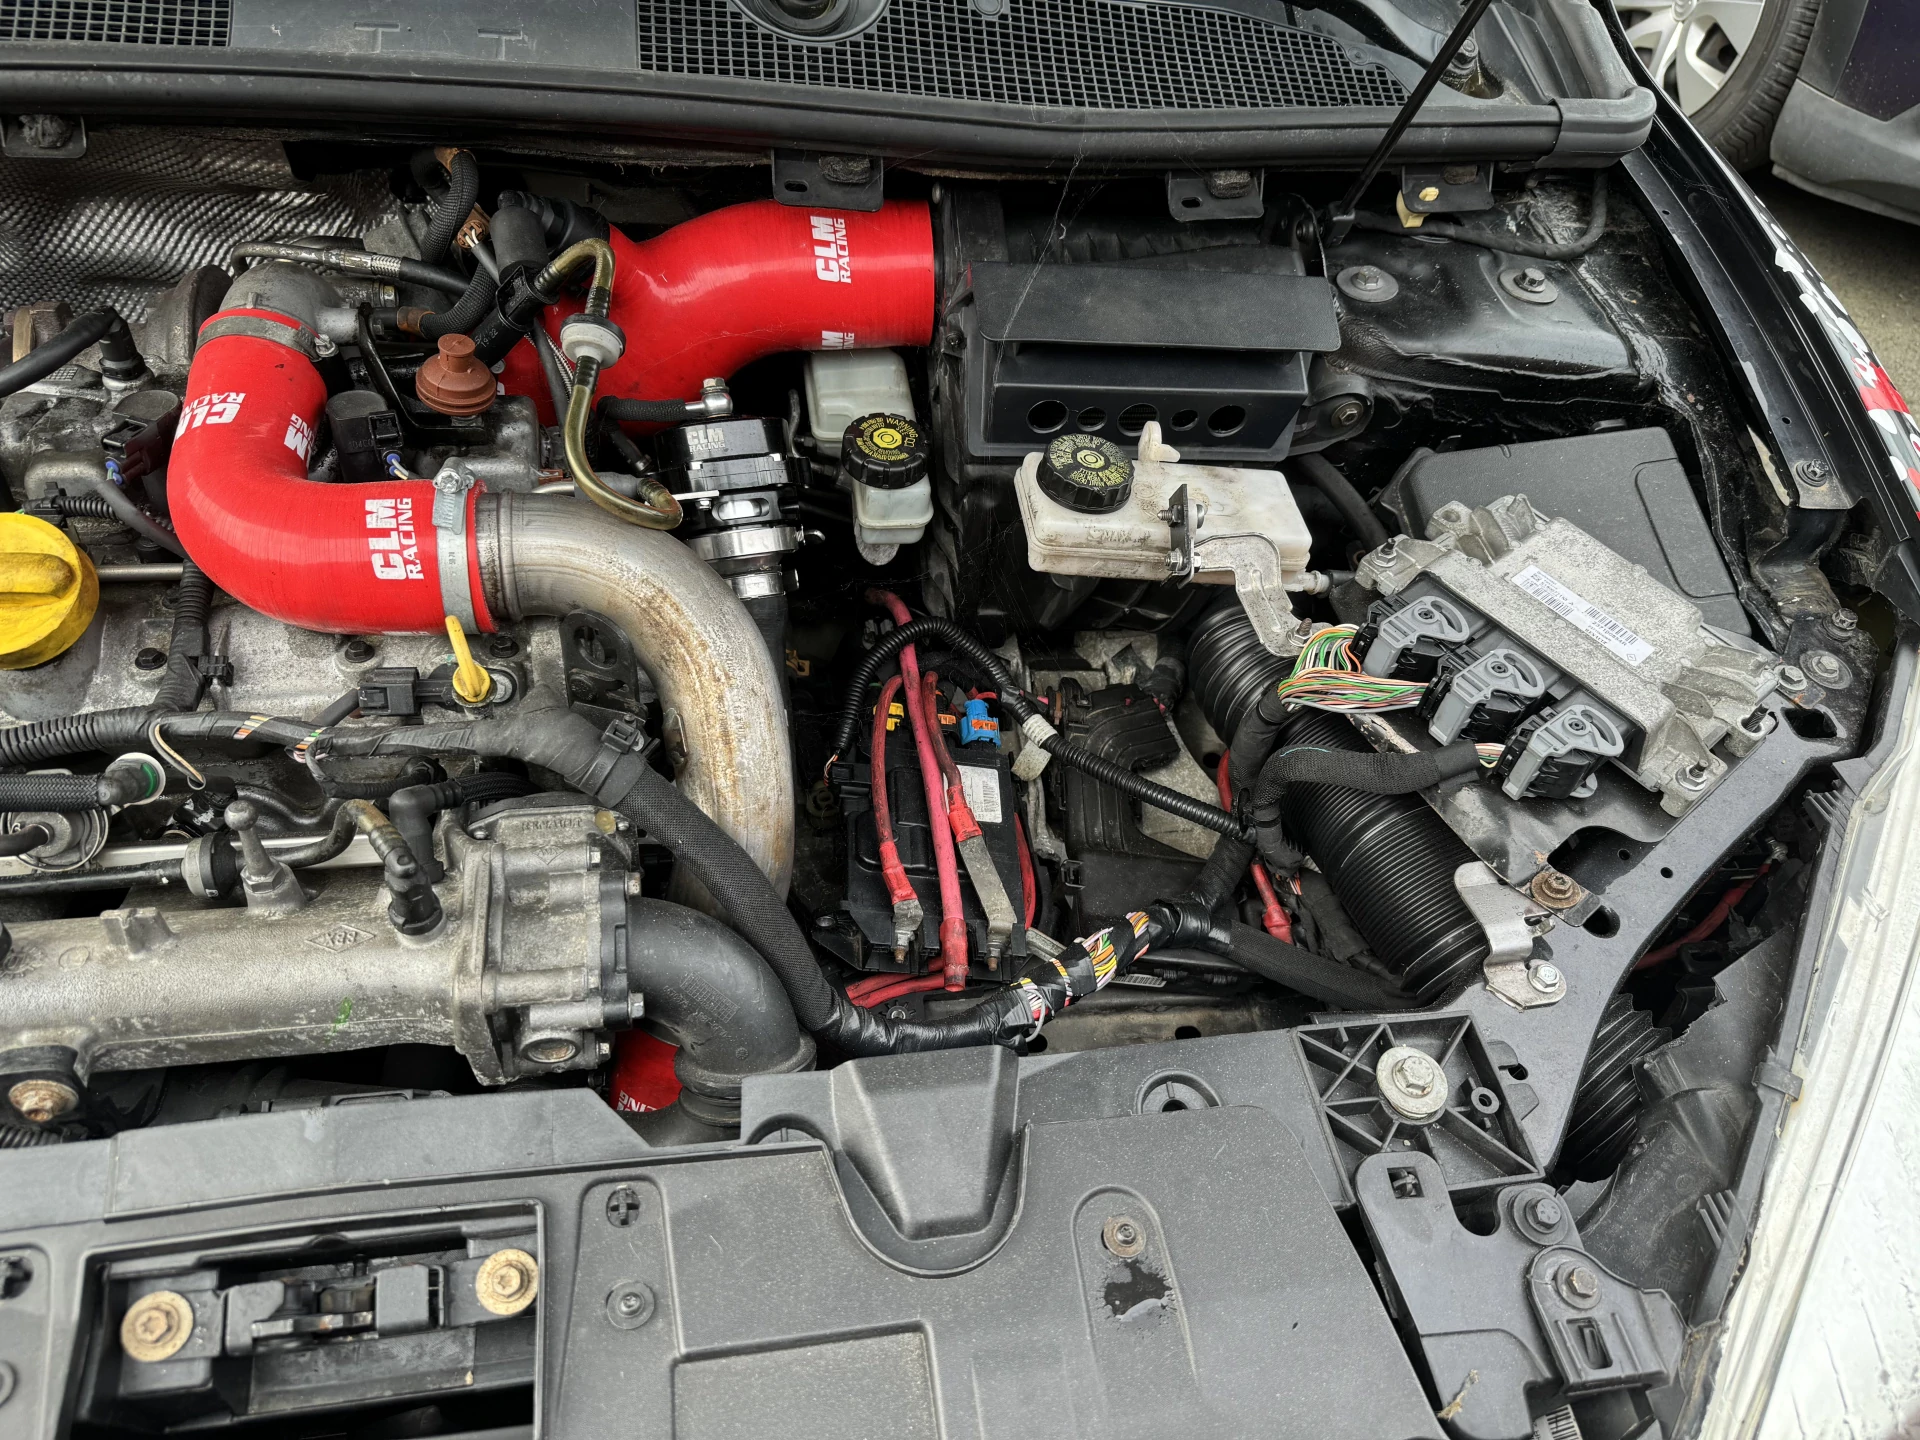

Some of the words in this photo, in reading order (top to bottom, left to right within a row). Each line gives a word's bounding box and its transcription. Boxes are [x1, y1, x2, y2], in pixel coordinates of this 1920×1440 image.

[810, 215, 840, 283] CLM
[833, 217, 852, 284] RACING
[686, 427, 725, 446] CLM
[688, 440, 726, 455] RACING
[885, 417, 919, 438] WARNING
[895, 426, 909, 437] SEE
[364, 498, 407, 580] CLM
[396, 497, 425, 580] RACING
